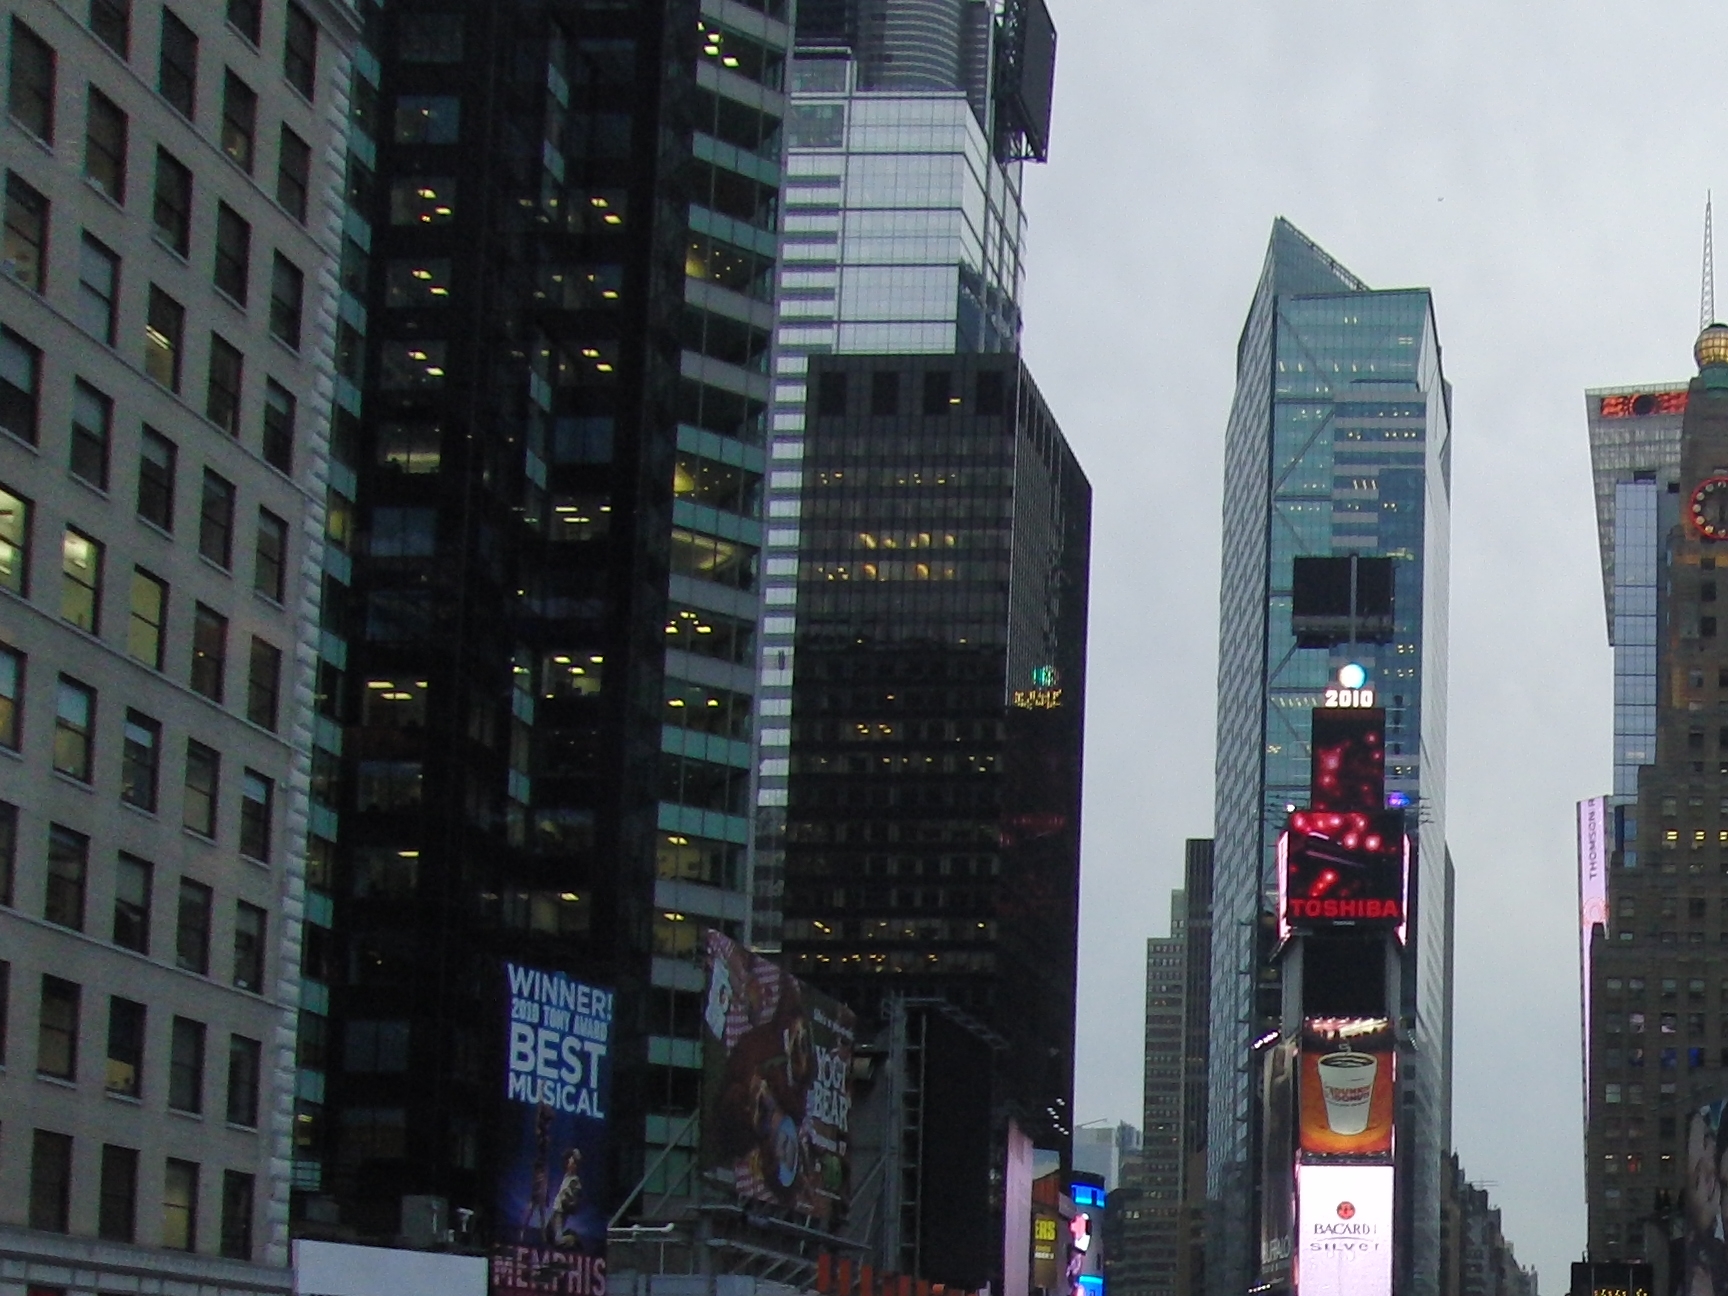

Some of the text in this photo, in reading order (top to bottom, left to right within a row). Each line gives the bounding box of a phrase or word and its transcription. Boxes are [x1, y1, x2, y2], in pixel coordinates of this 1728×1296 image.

[1324, 689, 1374, 708] 2010
[1588, 811, 1598, 880] THOMSON
[1291, 899, 1398, 918] TOSHIBA
[507, 963, 613, 1020] WINNER!
[543, 1006, 570, 1032] TONY
[573, 1015, 608, 1042] AWARD
[510, 1022, 606, 1088] BEST
[508, 1072, 604, 1119] MUSICAL
[1314, 1223, 1377, 1235] BACARDI
